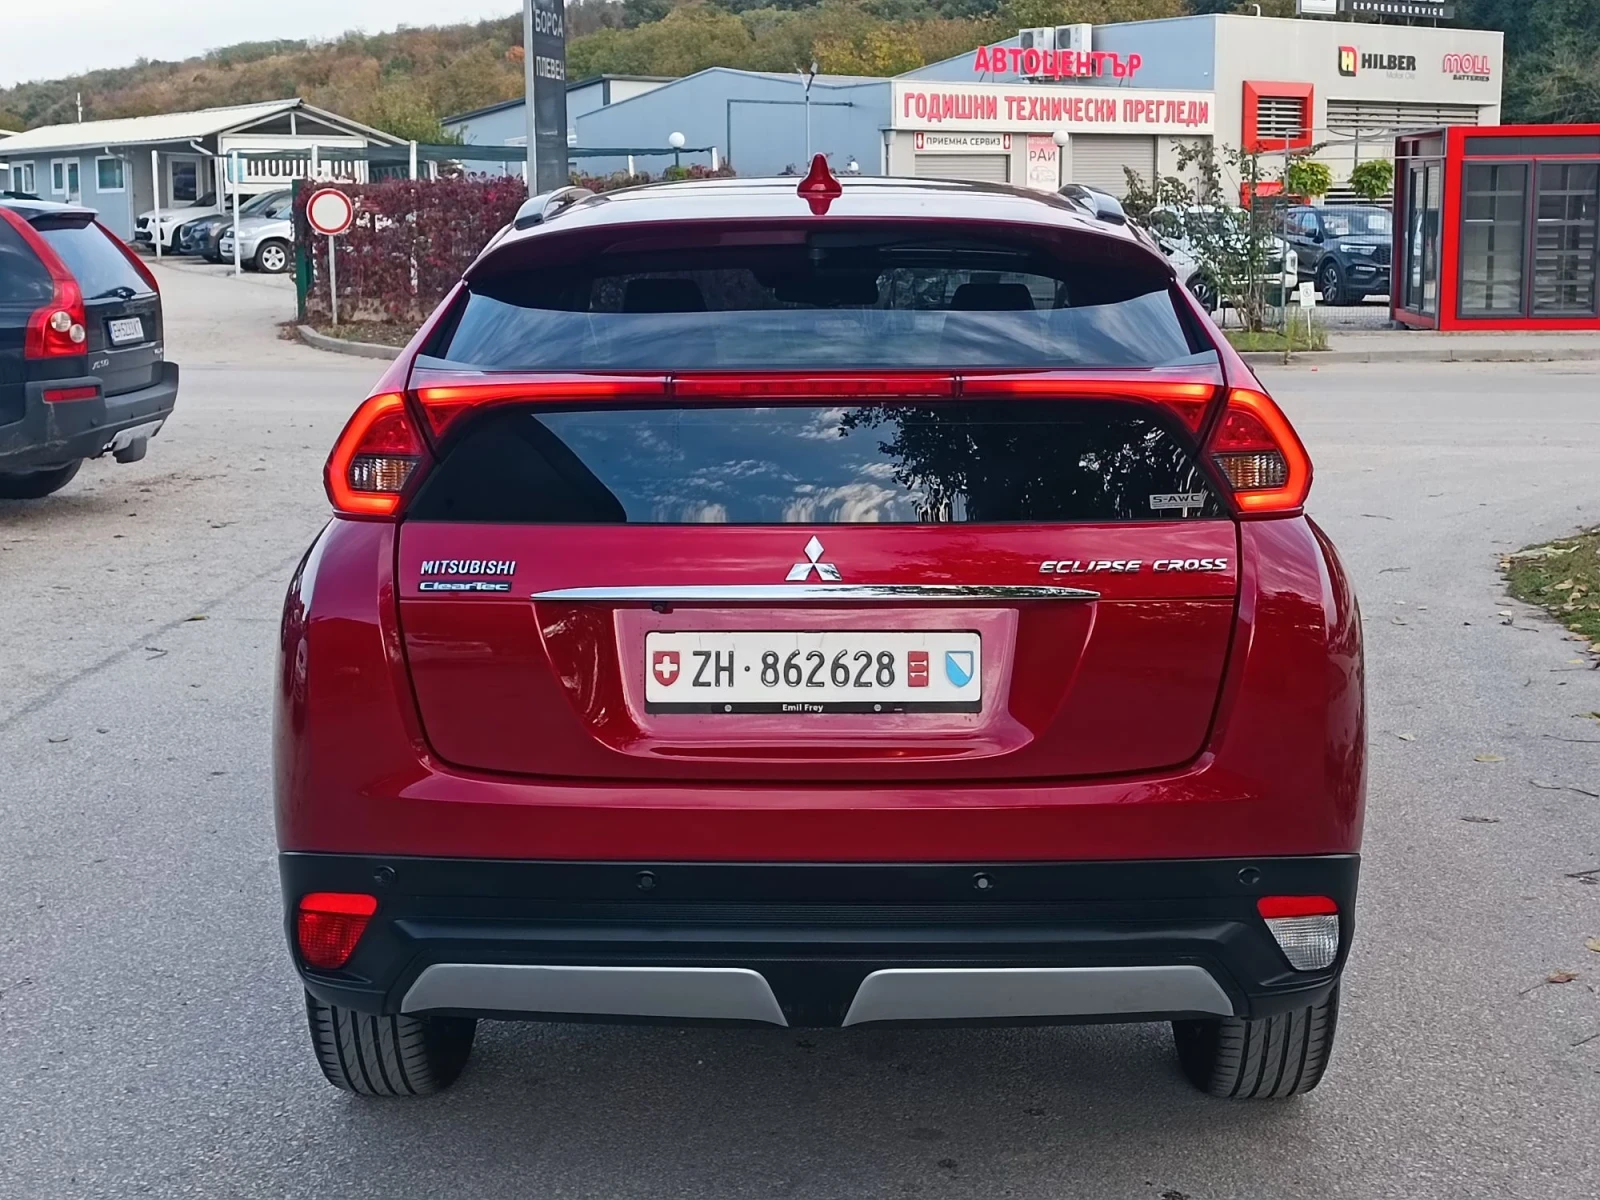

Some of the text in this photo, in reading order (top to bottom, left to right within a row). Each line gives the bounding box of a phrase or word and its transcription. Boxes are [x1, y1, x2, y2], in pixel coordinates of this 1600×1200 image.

[1353, 2, 1444, 16] EXPRESS SERVICE
[535, 8, 564, 38] БОРСА
[535, 55, 565, 81] ПЛЕВЕН
[973, 46, 1142, 80] АВТОЦЕНТЪР
[1361, 53, 1417, 71] HILBER
[1442, 53, 1490, 75] MOLL
[1452, 74, 1490, 82] BATTERIES
[904, 92, 1209, 128] ГОДИШНИ ТЕХНИЧЕСКИ ПРЕГЛЕДИ
[926, 137, 1001, 146] ПРИЕМНА СЕРВИЗ
[1153, 494, 1201, 503] S-AWC
[420, 560, 516, 575] MITSUBISHI
[1039, 558, 1228, 574] ECLIPSE CROSS
[419, 581, 509, 591] ClearTec
[782, 703, 824, 713] Emil Frey
